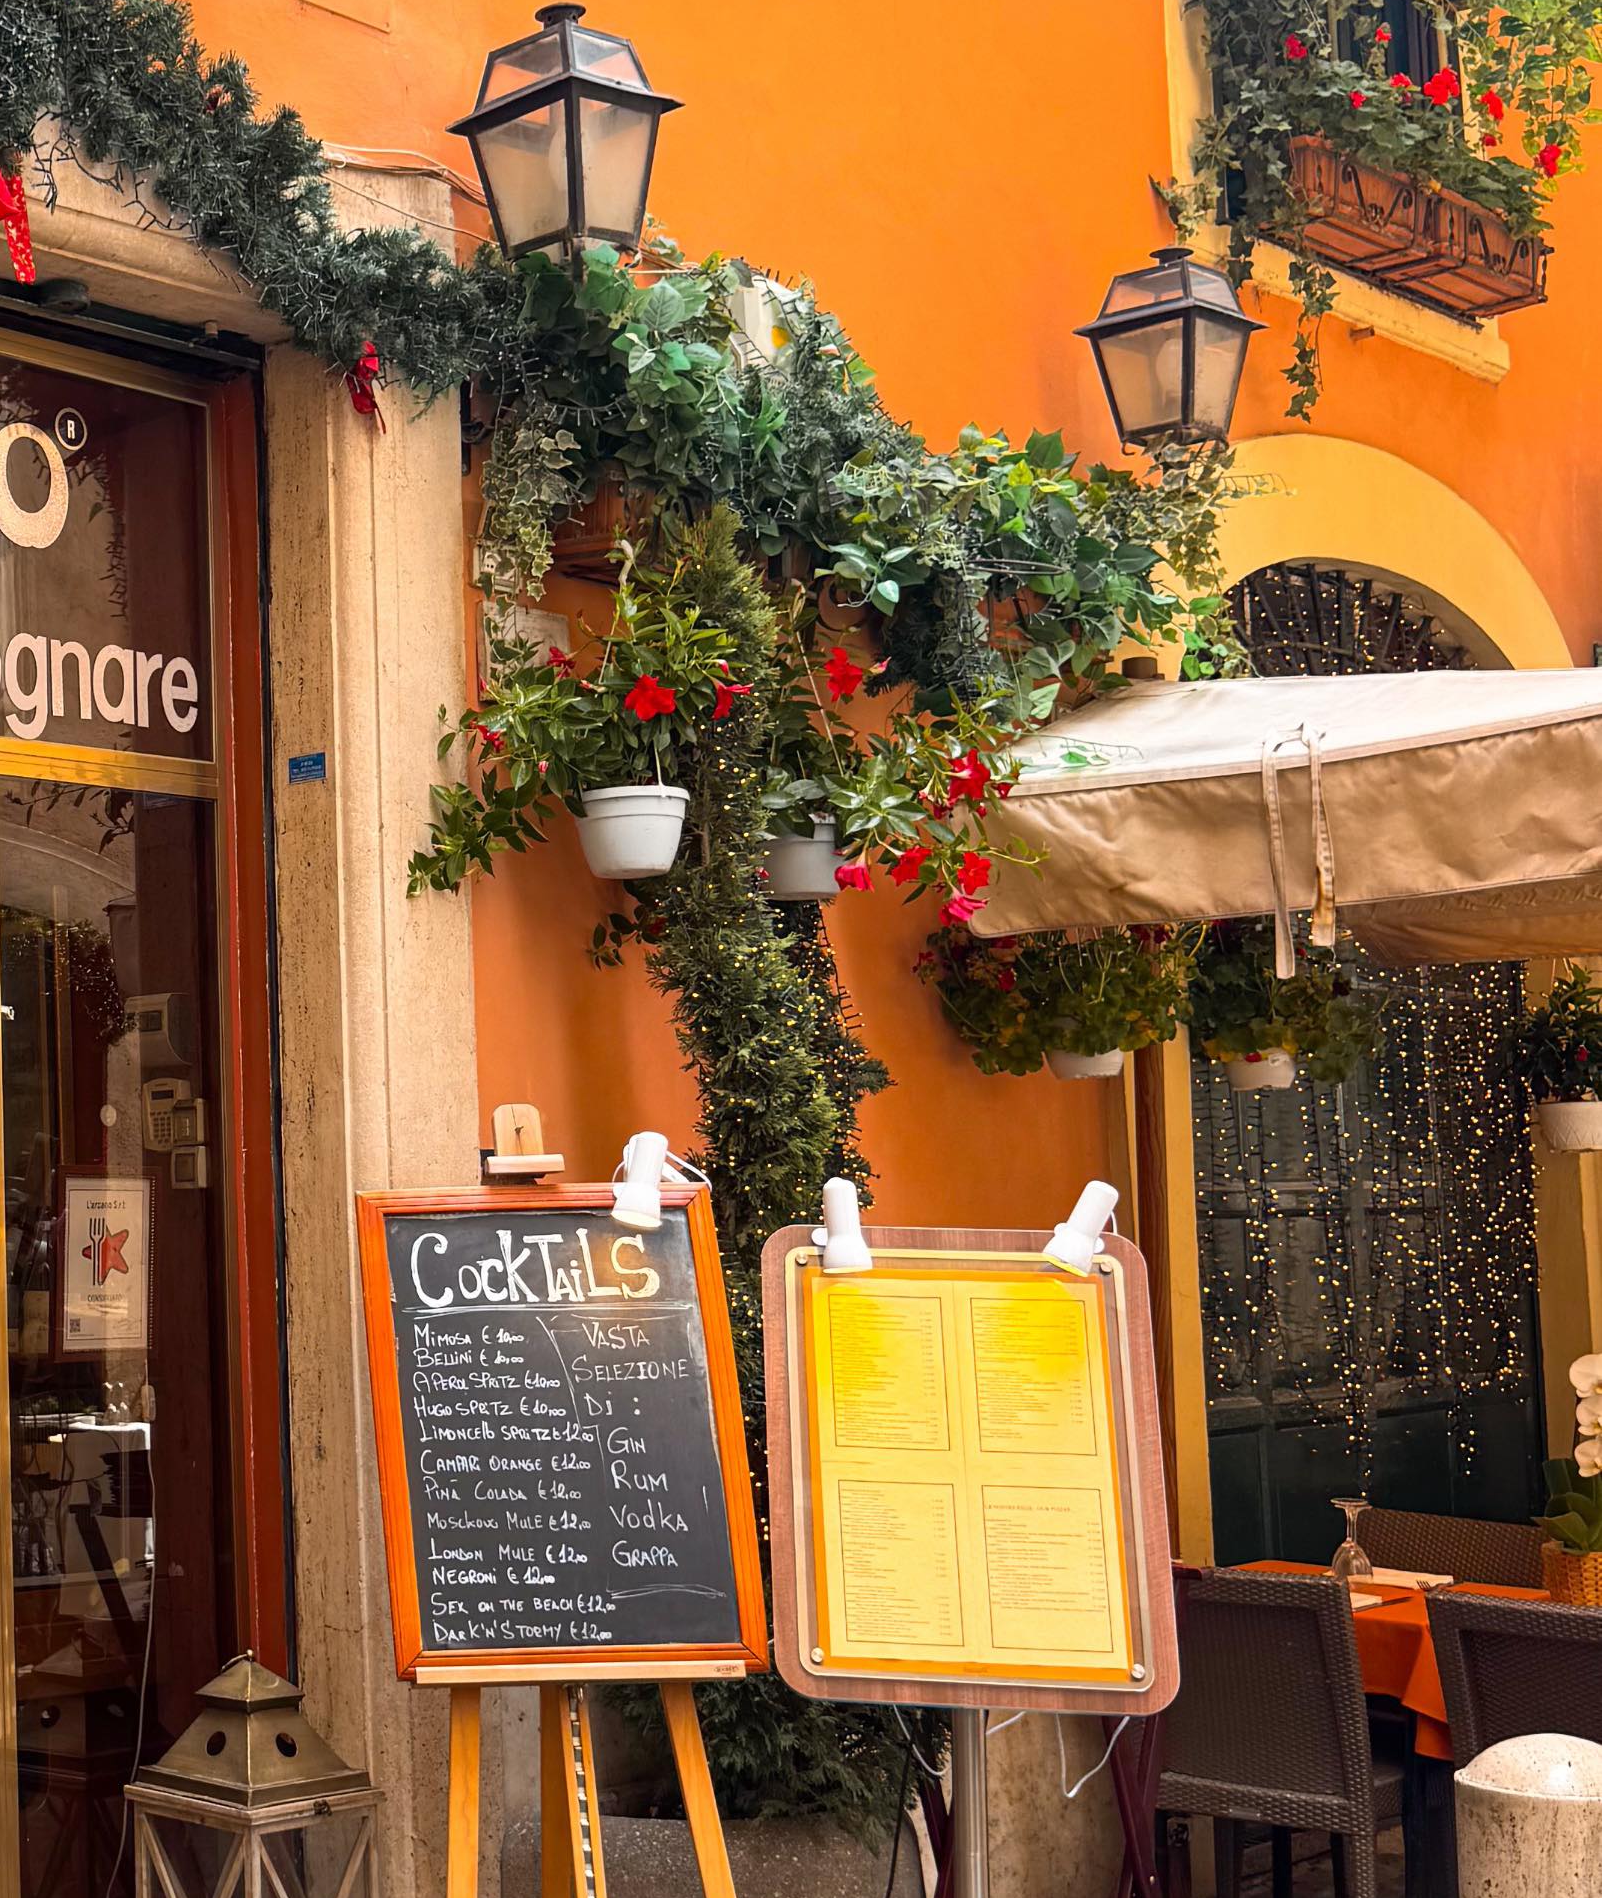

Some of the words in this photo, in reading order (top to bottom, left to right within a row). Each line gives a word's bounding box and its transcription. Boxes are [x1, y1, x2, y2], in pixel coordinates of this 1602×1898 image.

[582, 1321, 650, 1349] VASTA
[571, 1354, 689, 1383] SELEZIONE
[489, 1455, 543, 1472] ORANGE
[611, 1459, 669, 1492] RUM
[474, 1480, 528, 1501] COLADA
[428, 1537, 484, 1561] LONDON
[612, 1540, 678, 1567] GRAPPA
[430, 1592, 468, 1616] SEX
[478, 1600, 495, 1612] ON
[499, 1598, 524, 1612] THE
[533, 1597, 573, 1611] BEACH
